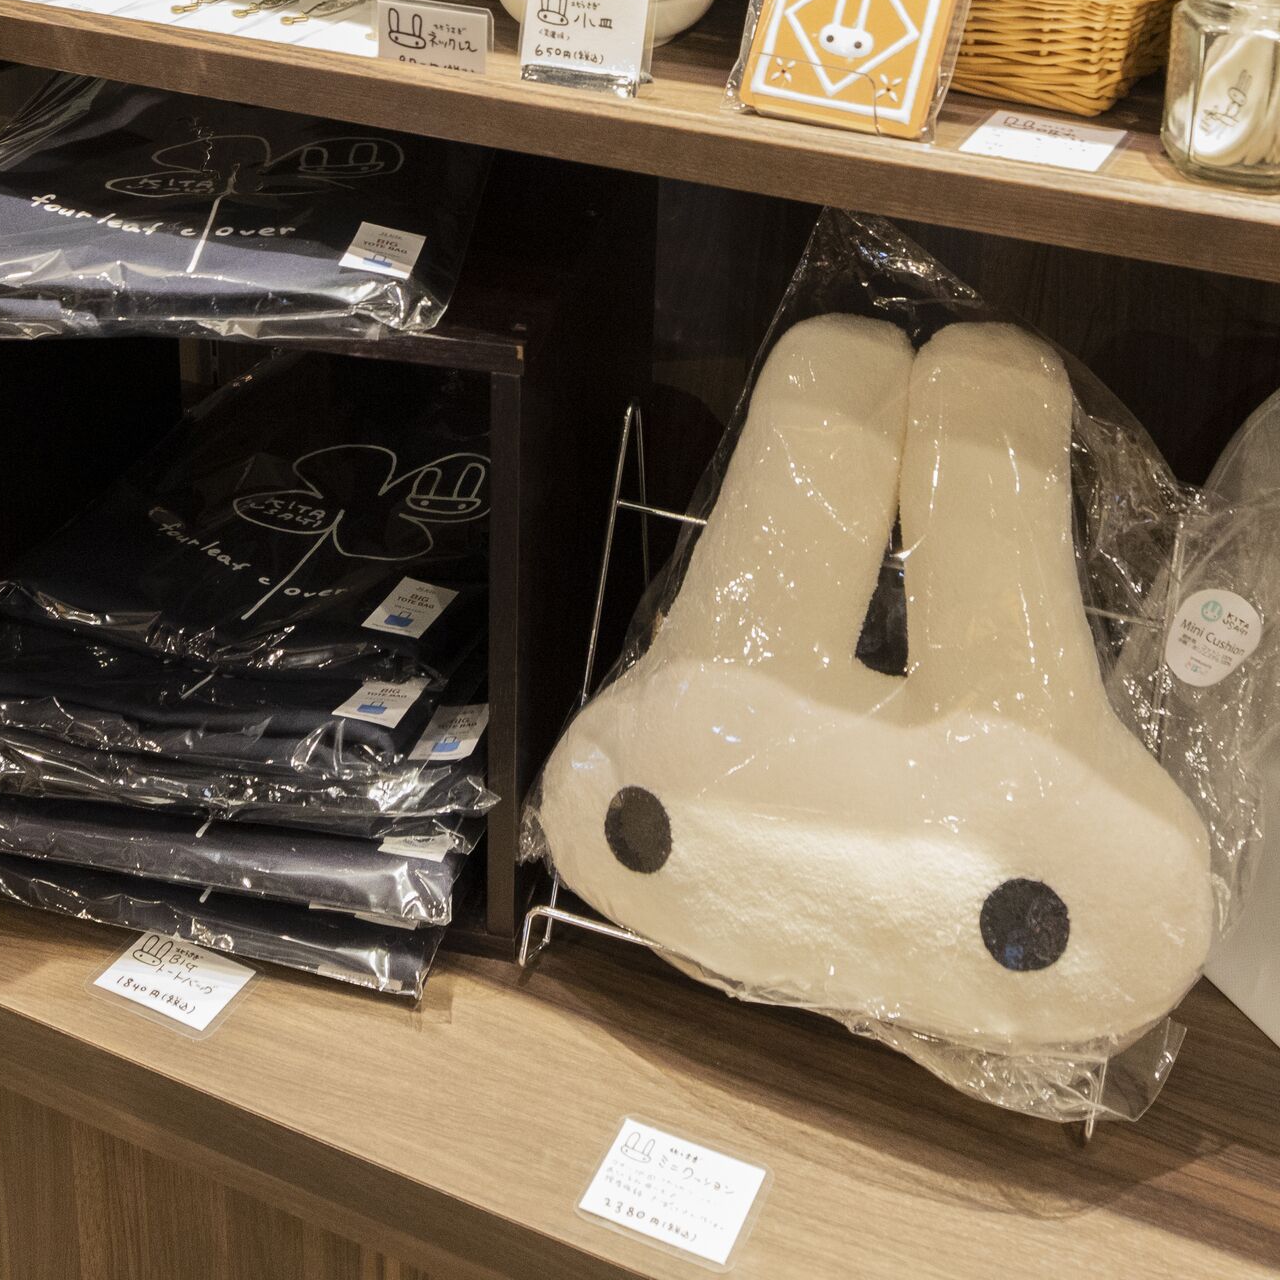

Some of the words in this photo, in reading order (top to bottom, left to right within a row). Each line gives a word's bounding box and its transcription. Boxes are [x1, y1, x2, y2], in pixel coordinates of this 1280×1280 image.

[573, 12, 613, 30] 小皿
[427, 31, 477, 53] ネックレス
[31, 193, 92, 219] four
[97, 213, 163, 235] leaf
[363, 241, 386, 249] TOTE
[376, 239, 398, 247] BIG
[267, 497, 326, 520] KITA
[158, 522, 199, 545] four
[200, 541, 250, 570] leaf
[397, 596, 417, 605] TOTE
[410, 593, 430, 602] BIG
[1227, 612, 1249, 629] KITA
[1181, 619, 1205, 637] Mini
[1206, 632, 1245, 656] Cushion
[169, 955, 198, 972] BIG
[156, 964, 218, 994] トートバッグ
